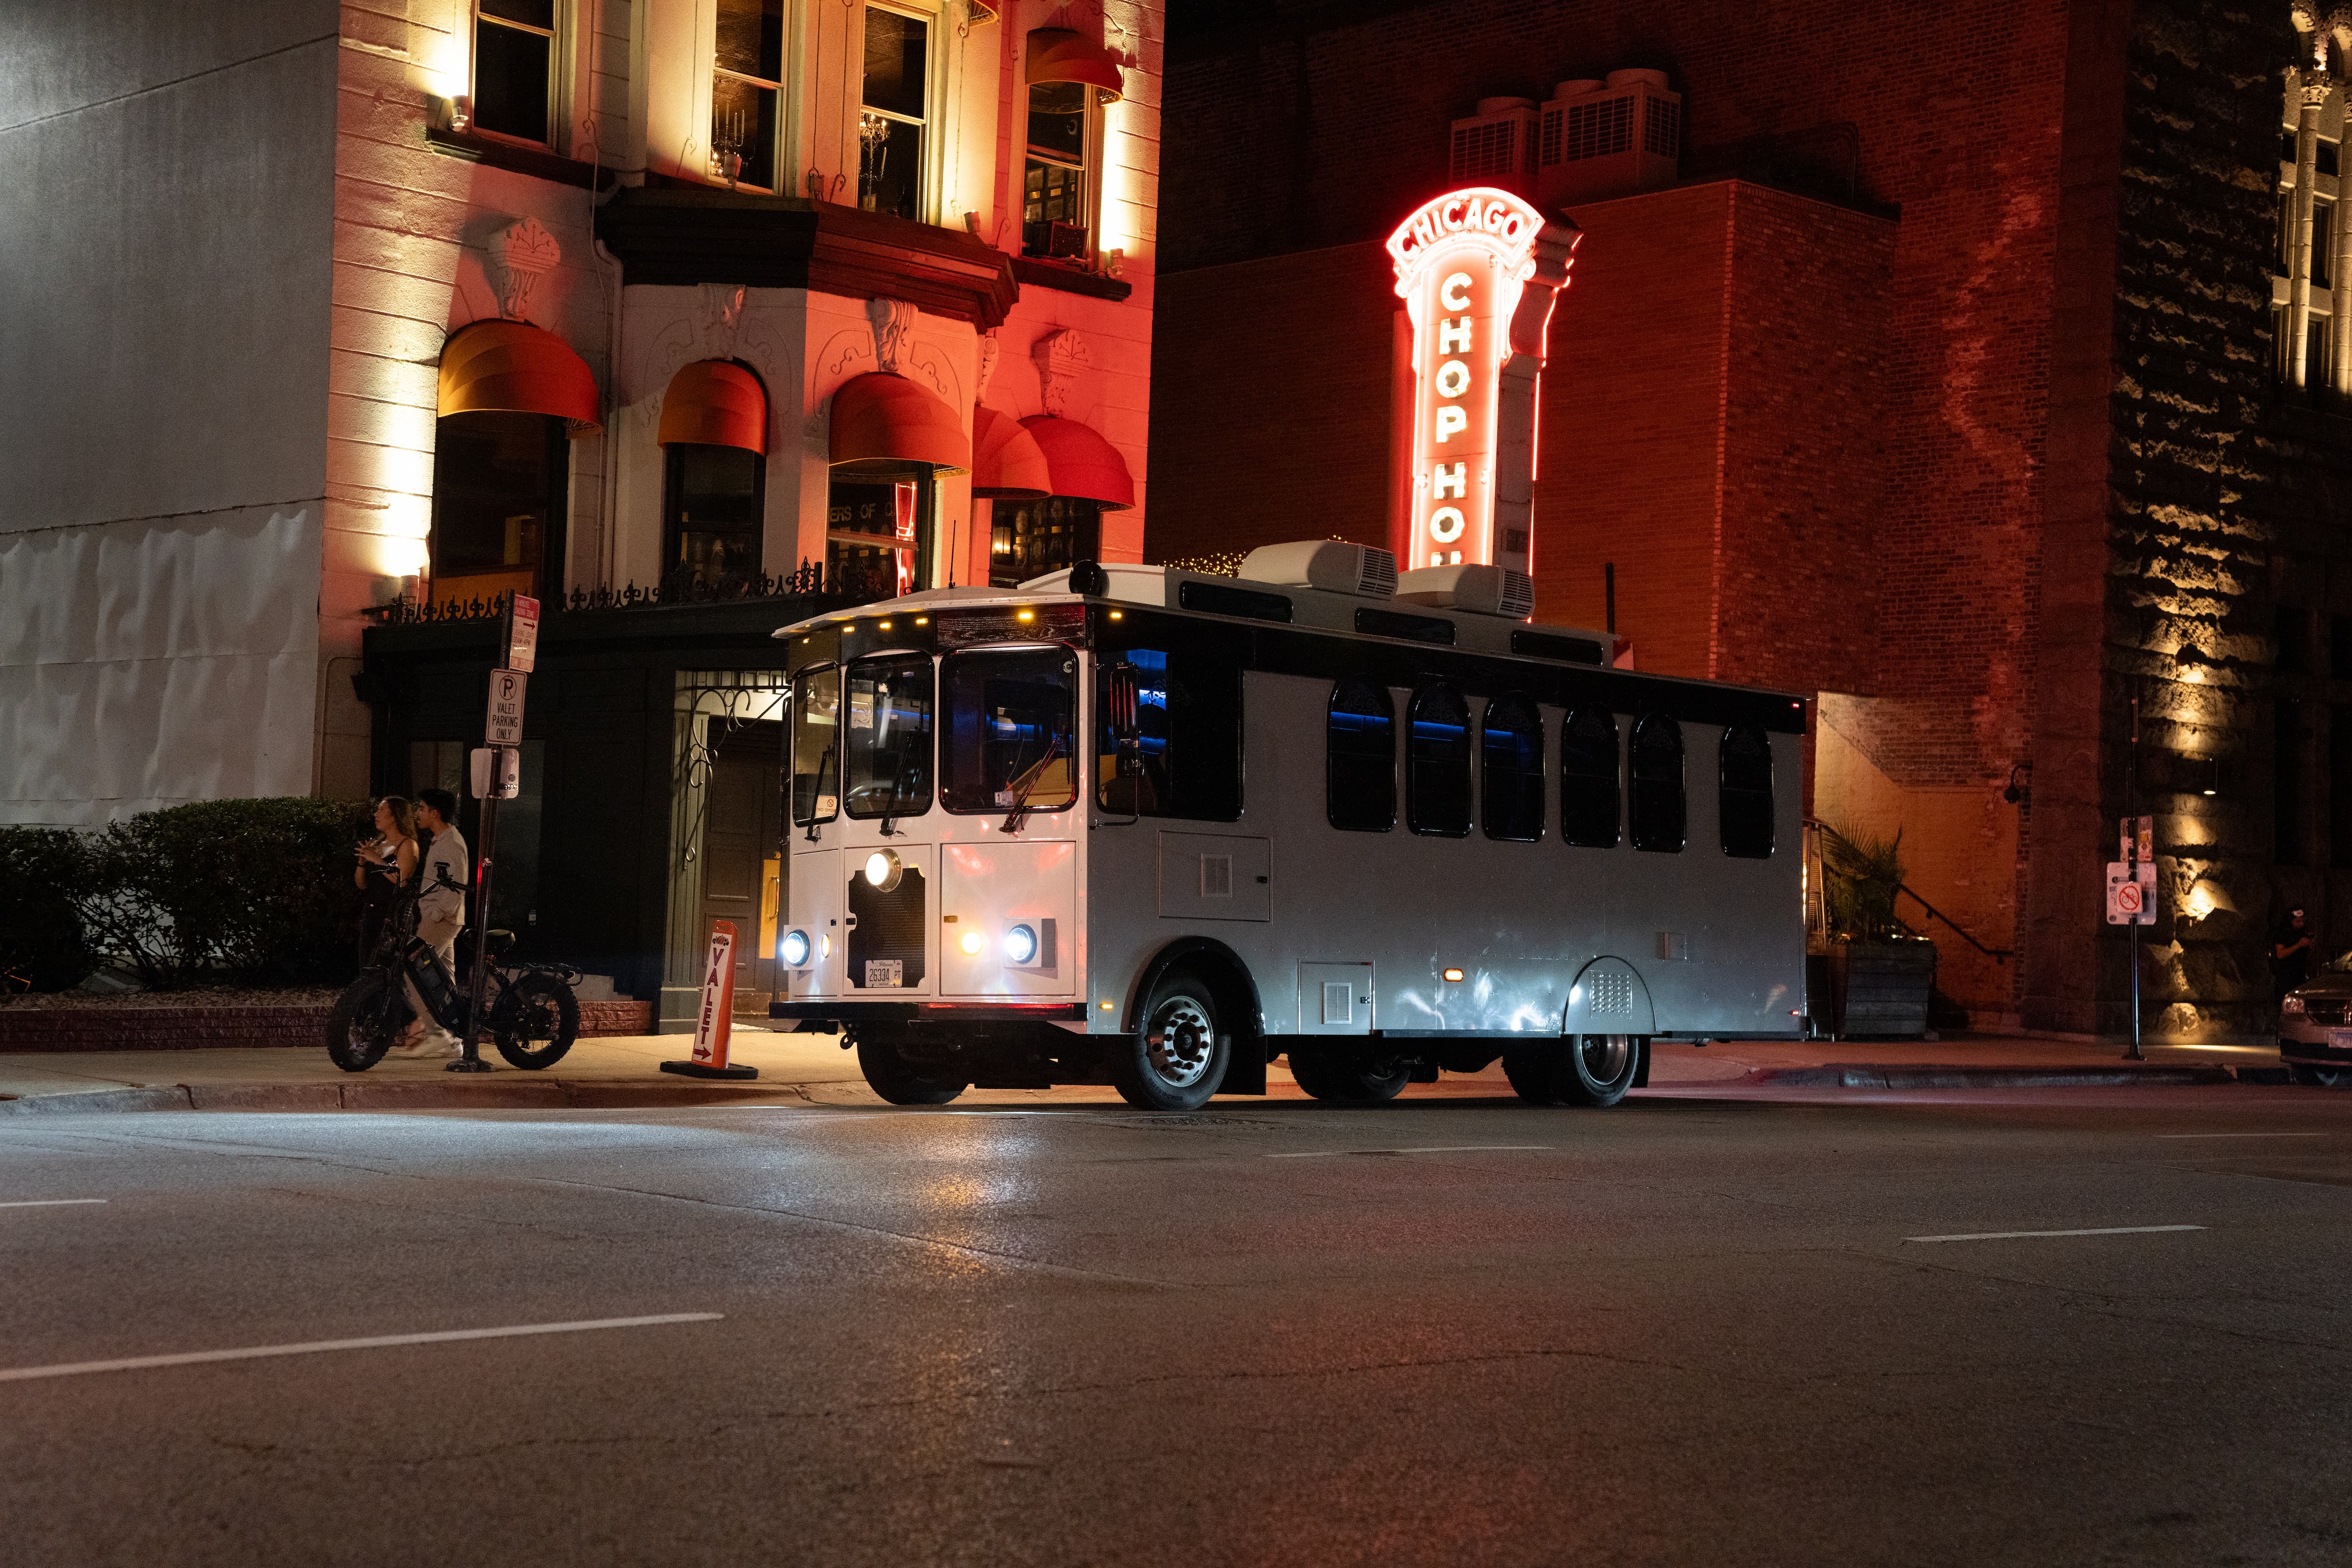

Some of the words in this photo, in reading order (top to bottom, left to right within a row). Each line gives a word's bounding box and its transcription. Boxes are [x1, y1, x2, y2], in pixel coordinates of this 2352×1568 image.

[1396, 197, 1526, 260] CHICAGO
[1435, 272, 1474, 443] CHOP
[497, 702, 515, 714] VALET
[492, 715, 518, 728] PARKING
[496, 728, 512, 740] ONLY
[869, 968, 889, 981] 26334
[894, 971, 901, 979] PT
[701, 947, 725, 1045] VALET
